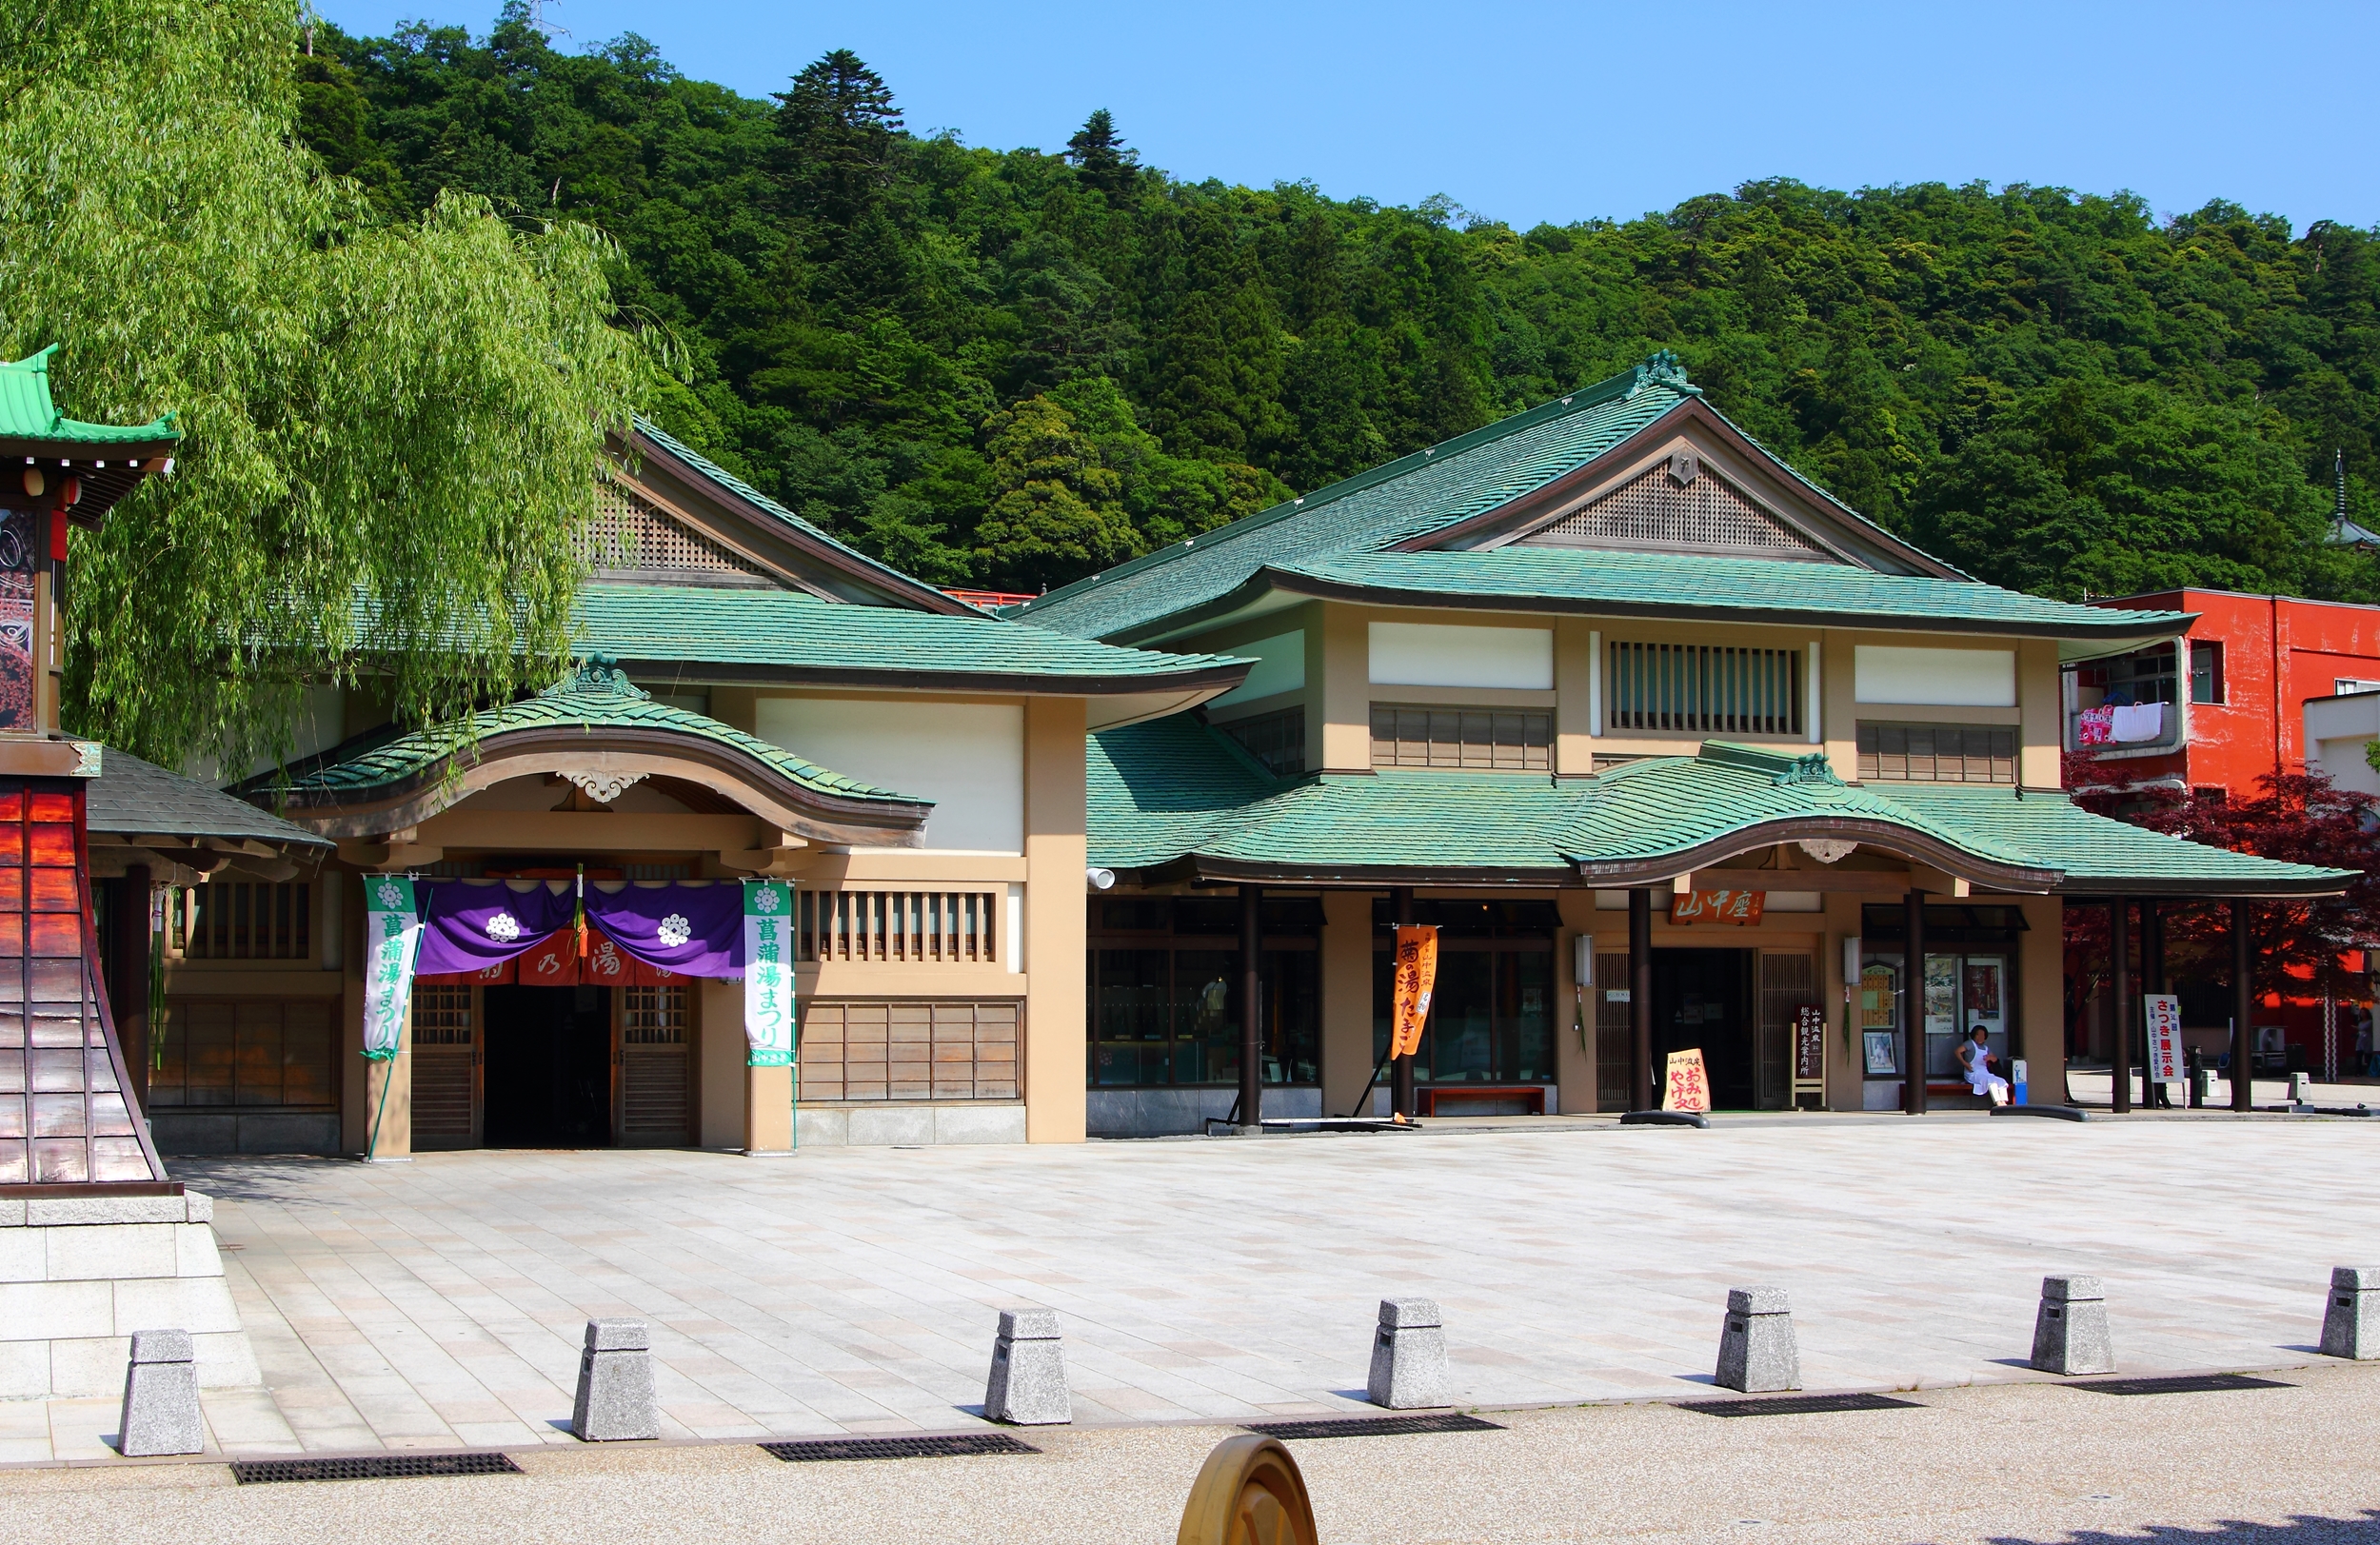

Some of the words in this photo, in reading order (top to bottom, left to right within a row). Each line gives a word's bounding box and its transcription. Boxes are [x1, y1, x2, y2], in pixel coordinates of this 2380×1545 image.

[1676, 890, 1752, 918] 山中座
[755, 918, 782, 1047] 菖蒲湯まつり
[1799, 1006, 1810, 1076] 総合観光案内所
[1811, 1009, 1821, 1042] 山中温泉
[2157, 1000, 2173, 1077] さつき展示会
[1669, 1057, 1701, 1066] 山中温泉
